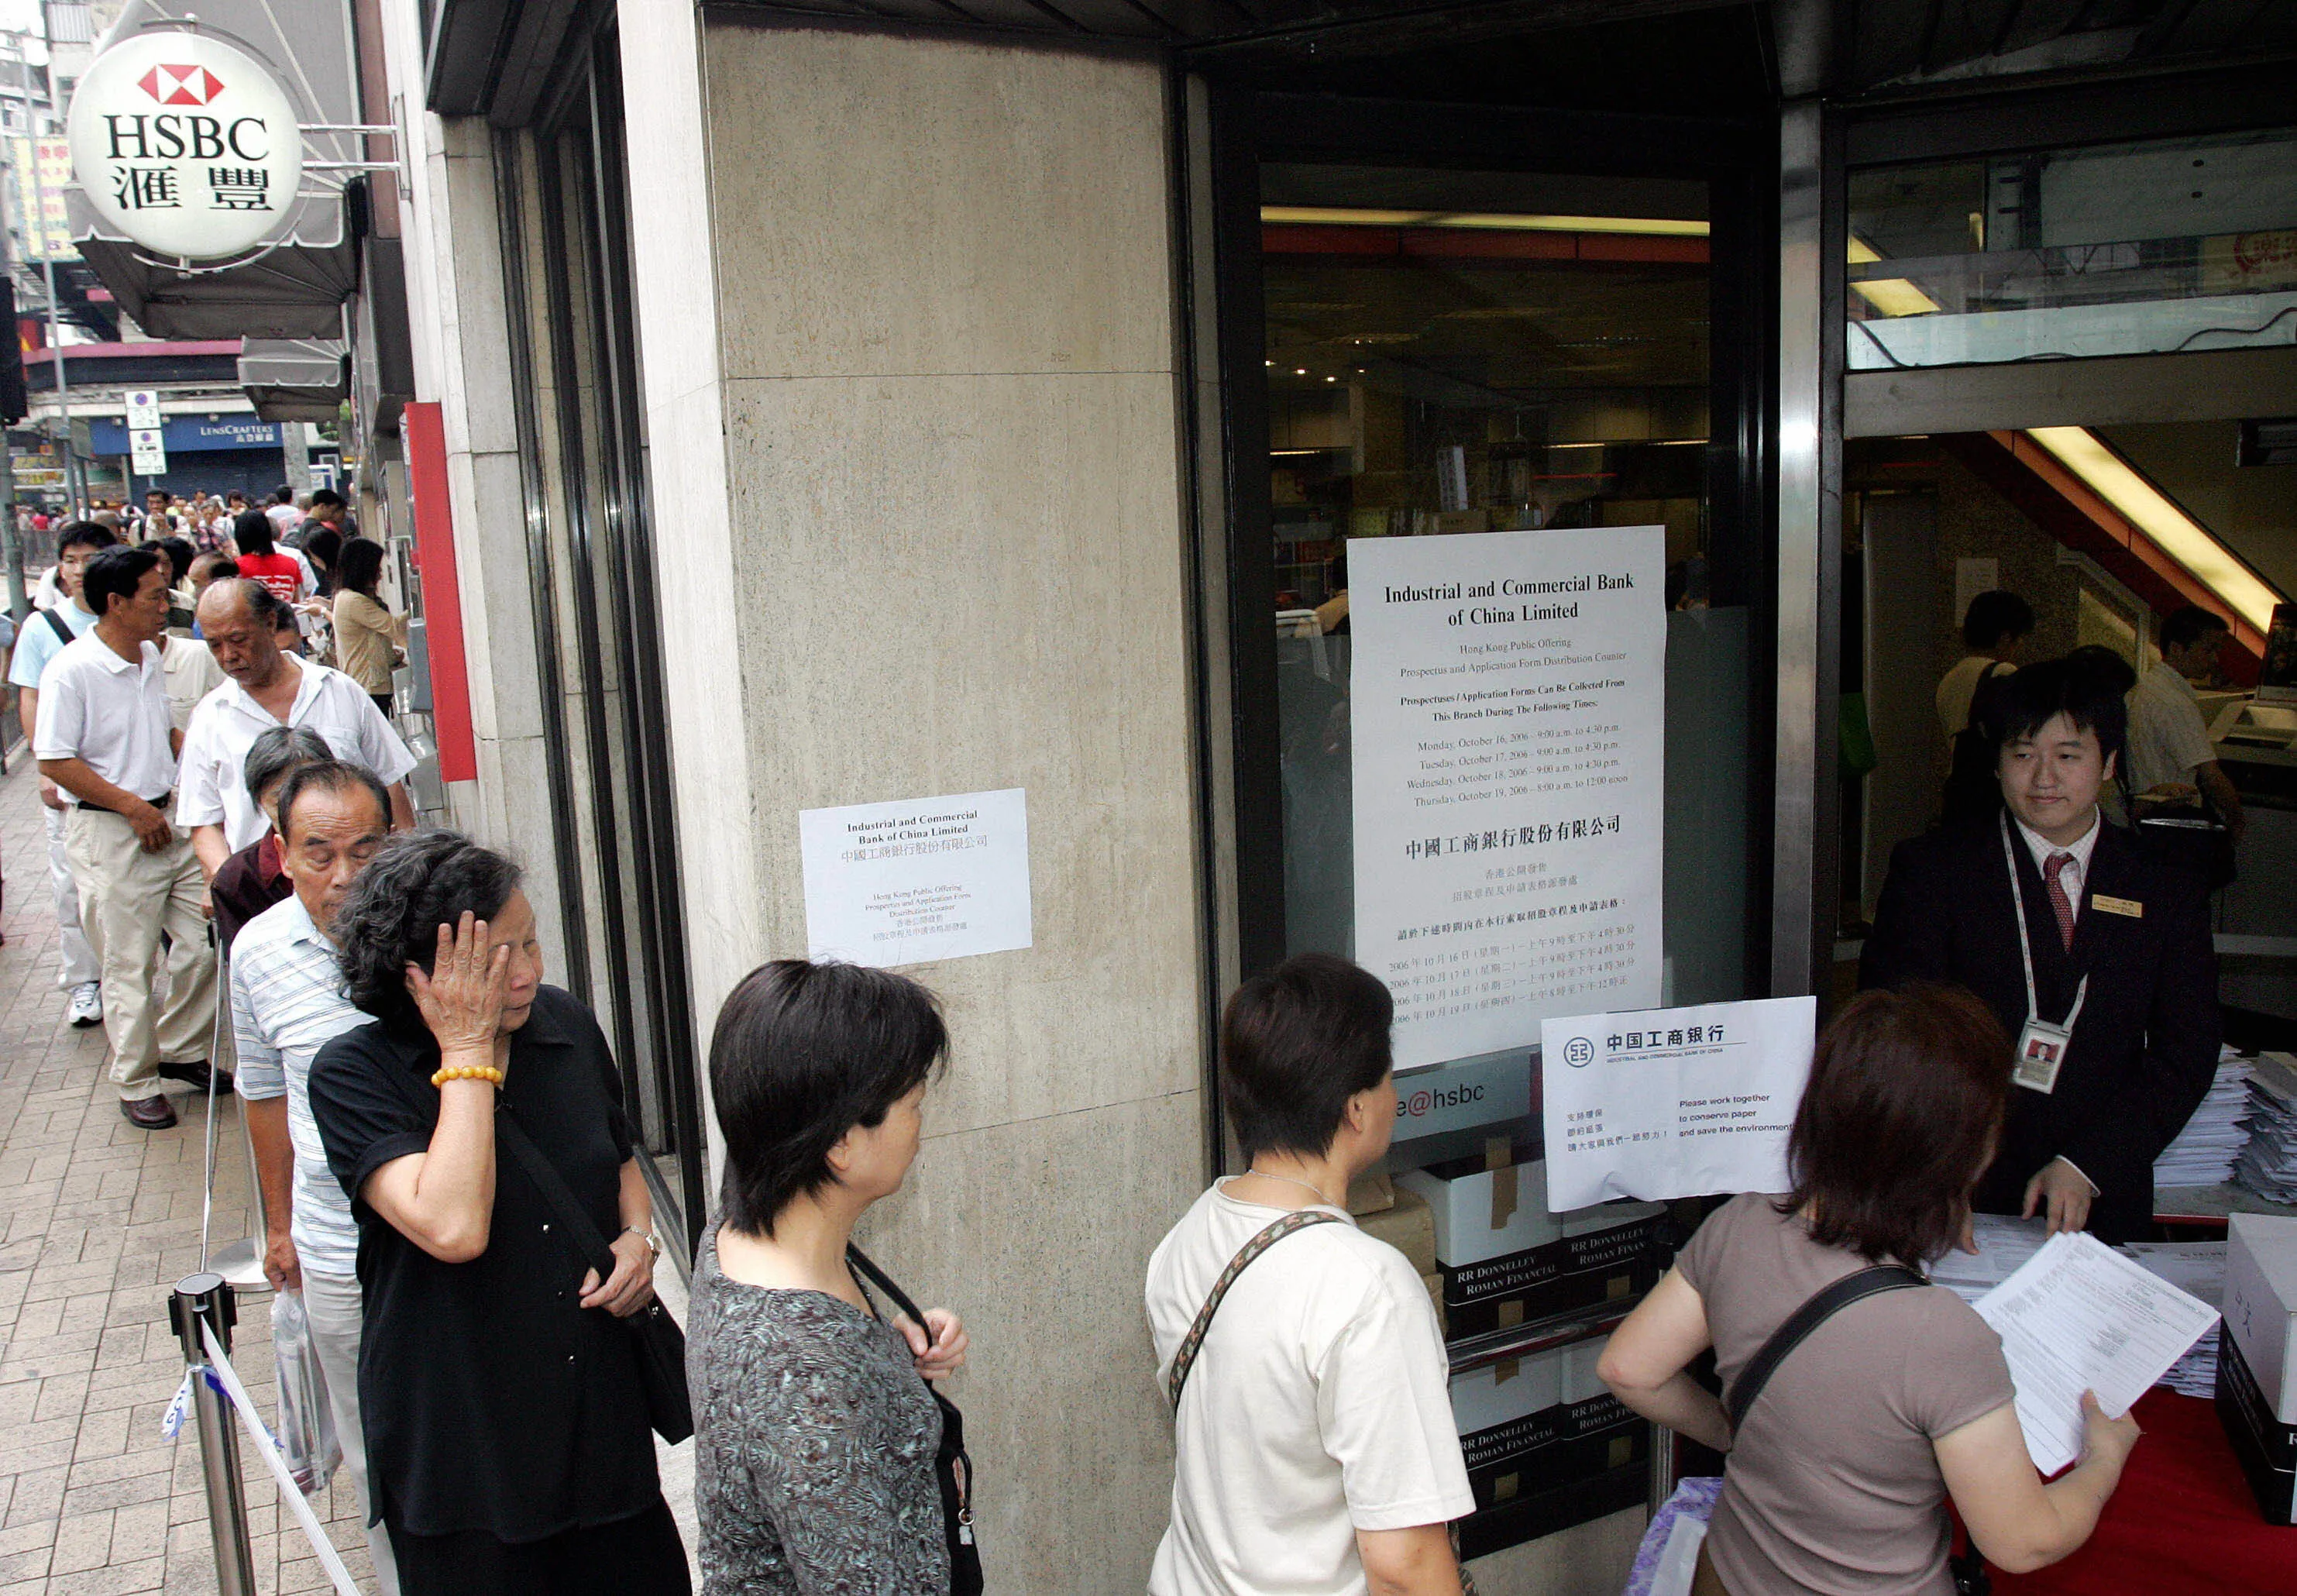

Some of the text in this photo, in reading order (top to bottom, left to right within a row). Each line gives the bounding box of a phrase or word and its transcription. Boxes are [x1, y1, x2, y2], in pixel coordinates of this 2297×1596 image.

[102, 115, 270, 161] HSBC
[1385, 573, 1634, 603] Industrial and Commercial Bank
[1448, 602, 1578, 626] of China Limited
[1460, 638, 1571, 655] Hong Kong Public Offering
[1400, 667, 1447, 678] Prospectus
[1449, 663, 1465, 673] and
[1469, 662, 1516, 673] Application
[1544, 654, 1593, 666] Distribution
[1595, 652, 1627, 662] Counter
[1401, 695, 1454, 706] Prospectuses
[1463, 690, 1508, 702] Application
[1511, 688, 1535, 697] Forms
[1538, 685, 1553, 694] Can
[1556, 684, 1566, 693] Be
[1569, 680, 1604, 691] Collected
[1606, 679, 1625, 688] From
[1432, 712, 1450, 721] This
[1453, 710, 1483, 720] Branch
[1486, 707, 1513, 717] During
[1516, 706, 1531, 714] The
[1534, 703, 1570, 712] Following
[1459, 738, 1493, 748] October
[1459, 755, 1492, 765] October
[1458, 773, 1491, 783] October
[1459, 791, 1491, 802] October
[848, 810, 978, 832] Industrial and Commercial
[859, 824, 968, 844] Bank of China Limited
[1406, 814, 1620, 859] 中國工商銀行股份有限公司
[1607, 1025, 1724, 1051] 中国工商银行
[1396, 1084, 1484, 1116] e@hsbc
[1680, 1099, 1707, 1108] Please
[1733, 1094, 1769, 1104] together
[1690, 1113, 1728, 1121] conserve
[1731, 1110, 1757, 1119] paper
[1680, 1128, 1694, 1137] and
[1697, 1126, 1717, 1135] save
[1571, 1227, 1643, 1252] RR DONNELLEY
[1457, 1254, 1536, 1283] RR DONNELLEY
[1580, 1250, 1614, 1265] ROMAN
[1467, 1264, 1556, 1295] ROMAN FINANCIAL
[1572, 1407, 1587, 1419] RR
[1580, 1414, 1613, 1429] ROMAN
[1478, 1422, 1535, 1446] DONNELLEY
[1468, 1428, 1555, 1463] ROMAN FINANCIAL
